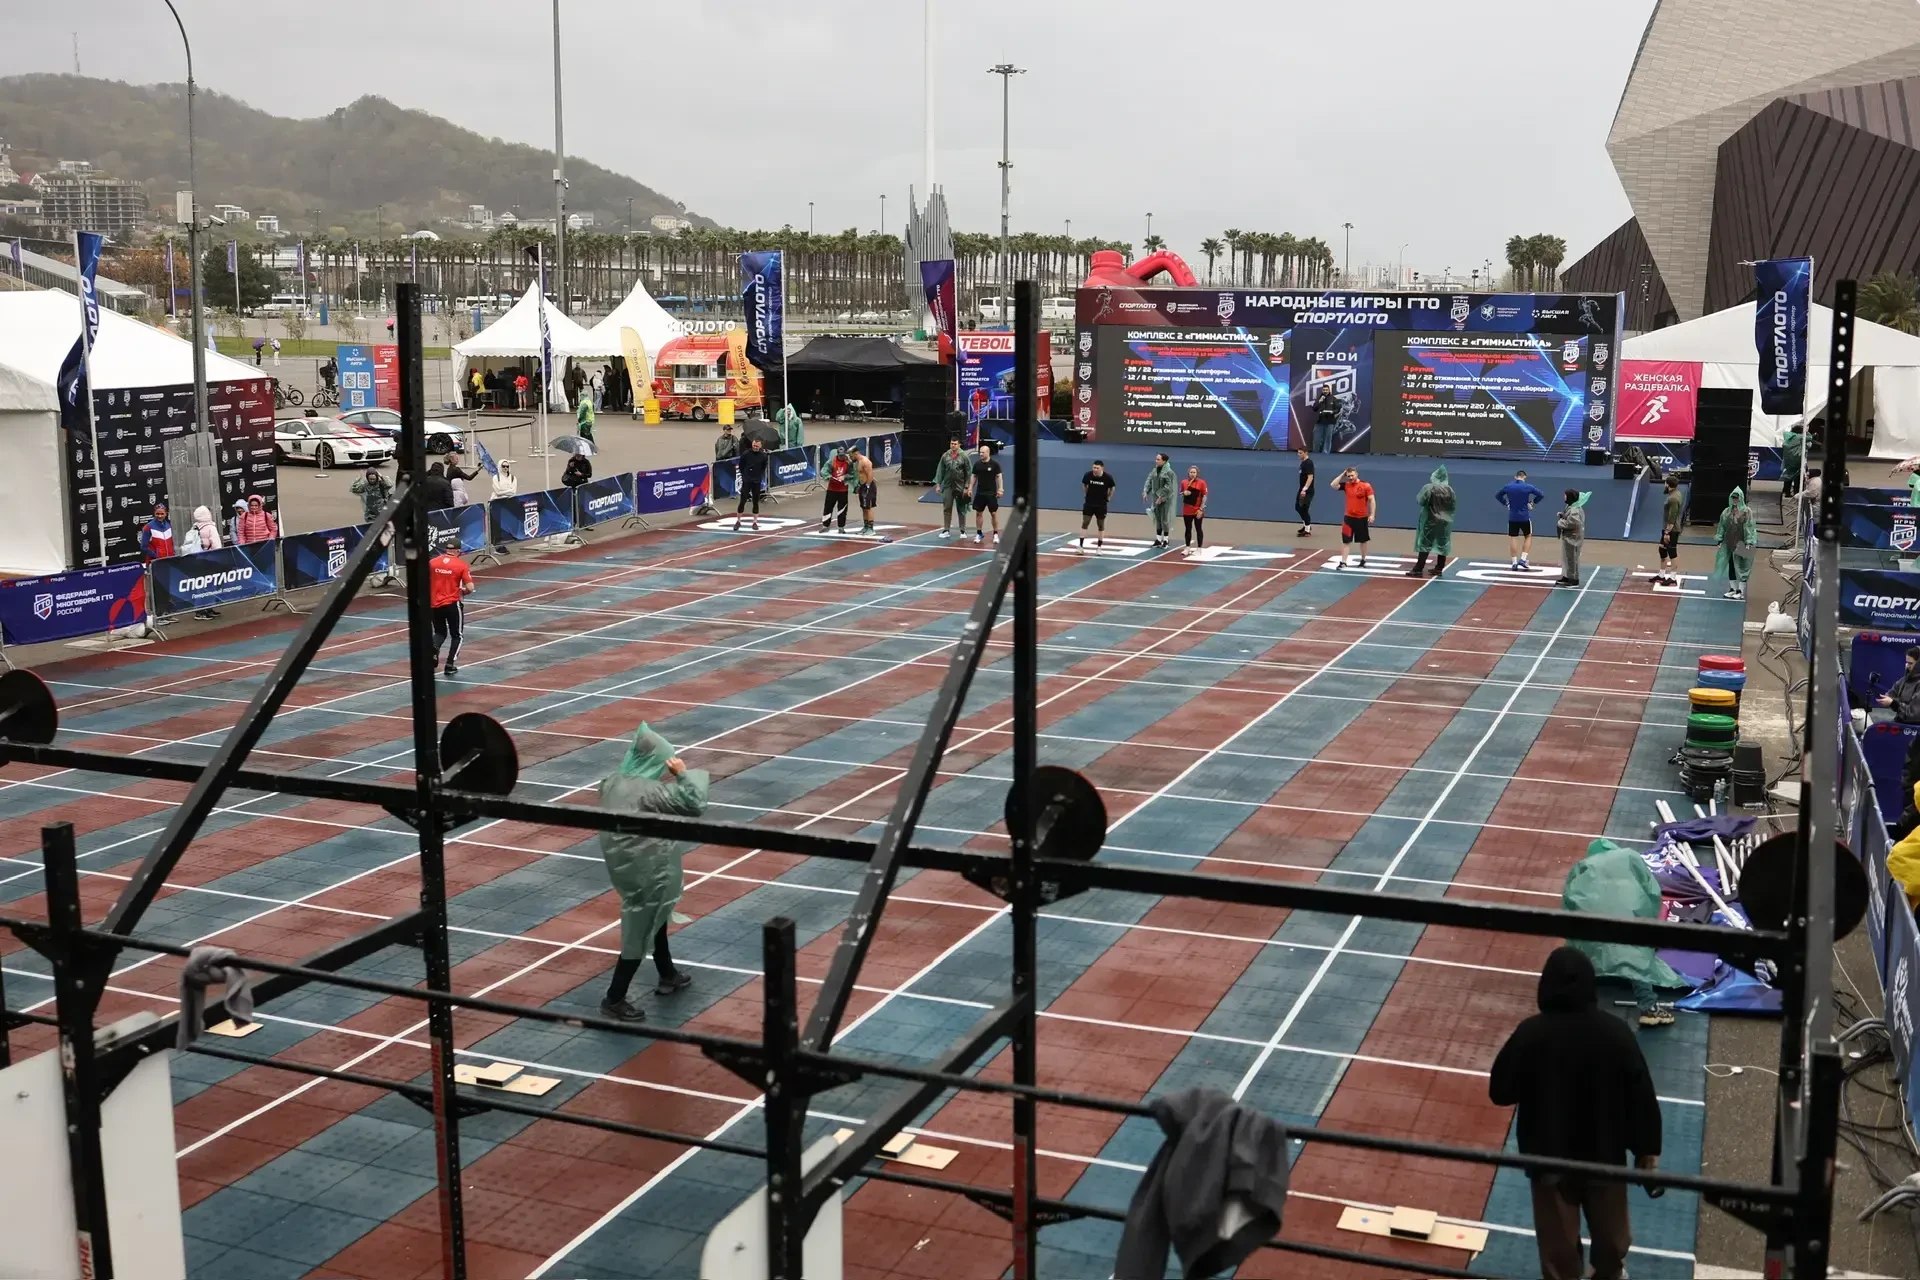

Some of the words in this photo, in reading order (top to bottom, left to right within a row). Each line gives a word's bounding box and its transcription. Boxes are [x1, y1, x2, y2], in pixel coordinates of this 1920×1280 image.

[1245, 296, 1346, 310] НАРОДНЫЕ
[1350, 296, 1402, 309] ИГРЫ
[1407, 298, 1440, 310] ГТО
[1294, 312, 1389, 326] СПОРТЛОТО
[1128, 332, 1175, 340] КОМПЛЕКС
[1185, 332, 1259, 342] «ГИМНАСТИКА»
[1774, 290, 1789, 389] СПОРТЛОТО
[961, 337, 1012, 350] TEBOIL
[1470, 339, 1552, 348] «ГИМНАСТИКА»
[1306, 351, 1358, 362] ГЕРОИ
[1633, 373, 1683, 384] ЖЕНСКАЯ
[1624, 382, 1690, 394] РАЗДЕВАЛКА
[778, 462, 808, 477] СПОРТЛОТО
[588, 492, 623, 510] СПОРТЛОТО
[1894, 530, 1913, 541] ГТО
[1182, 546, 1296, 562] 4
[330, 556, 344, 570] ГТО
[178, 566, 253, 593] СПОРТЛОТО
[56, 589, 96, 600] ФЕДЕРАЦИЯ
[56, 597, 101, 608] МНОГОБОРЬЯ
[101, 593, 114, 602] ГТО
[36, 600, 51, 611] ГТО
[57, 607, 82, 616] РОССИИ
[1871, 611, 1917, 620] Генеральный
[1881, 636, 1916, 644] @gtosport
